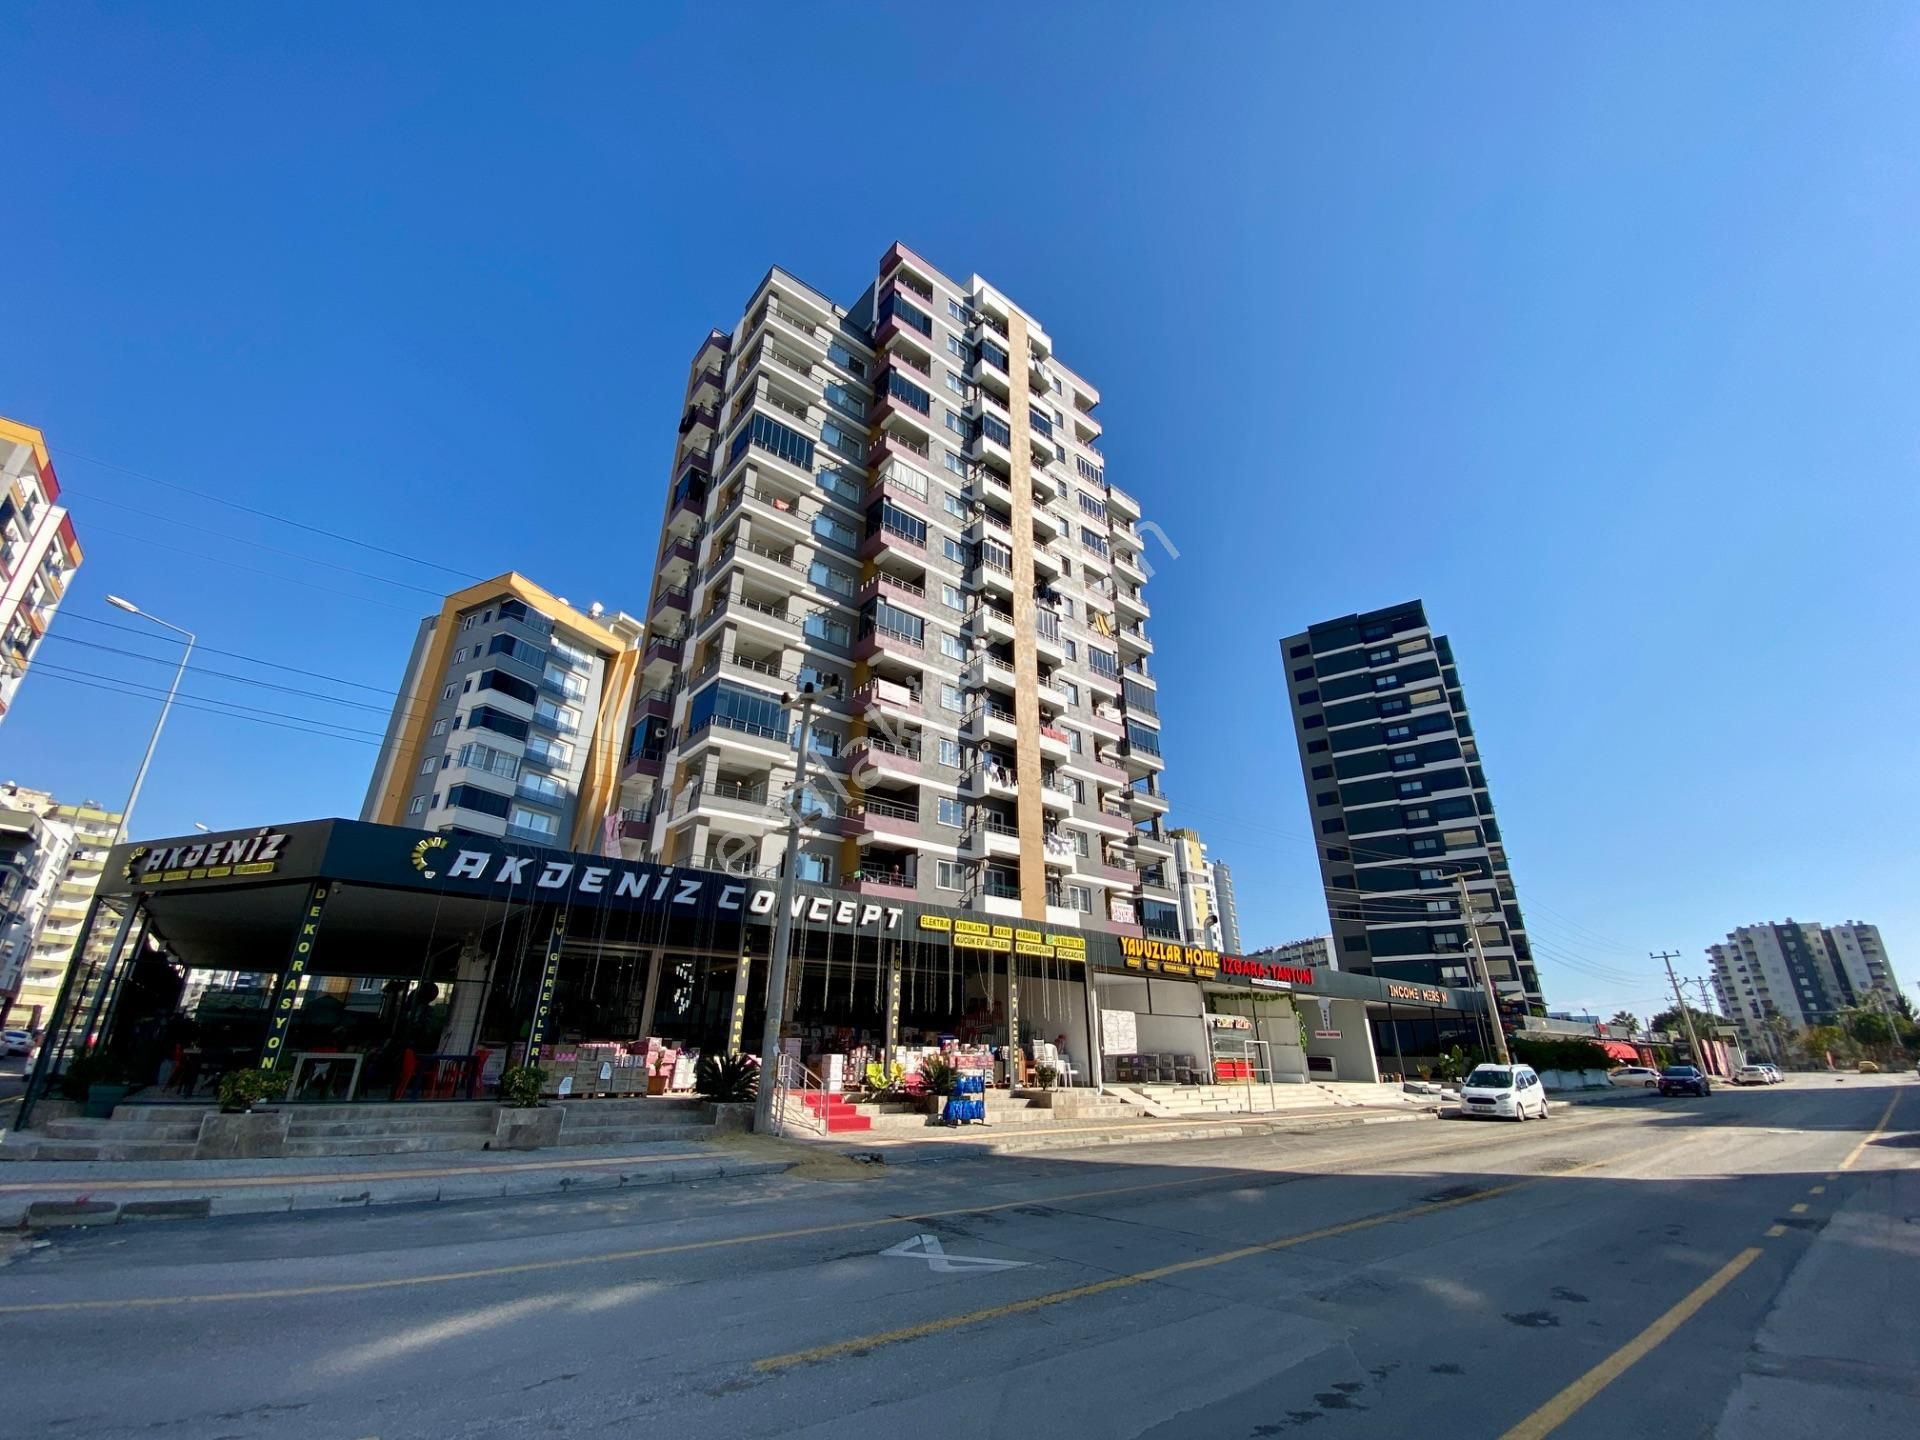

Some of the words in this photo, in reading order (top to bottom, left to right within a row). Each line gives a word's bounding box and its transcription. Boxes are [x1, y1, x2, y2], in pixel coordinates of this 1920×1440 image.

[144, 827, 286, 871] AKDENİZ
[447, 849, 704, 906] AKDENİZ
[717, 885, 904, 929] CONCEPT
[994, 926, 1011, 938] DEKOR
[1120, 936, 1182, 963] YAVUZLAR
[1184, 947, 1220, 969] HOME
[261, 888, 327, 1069] DEKORASYON
[1389, 984, 1419, 1000] INCOME
